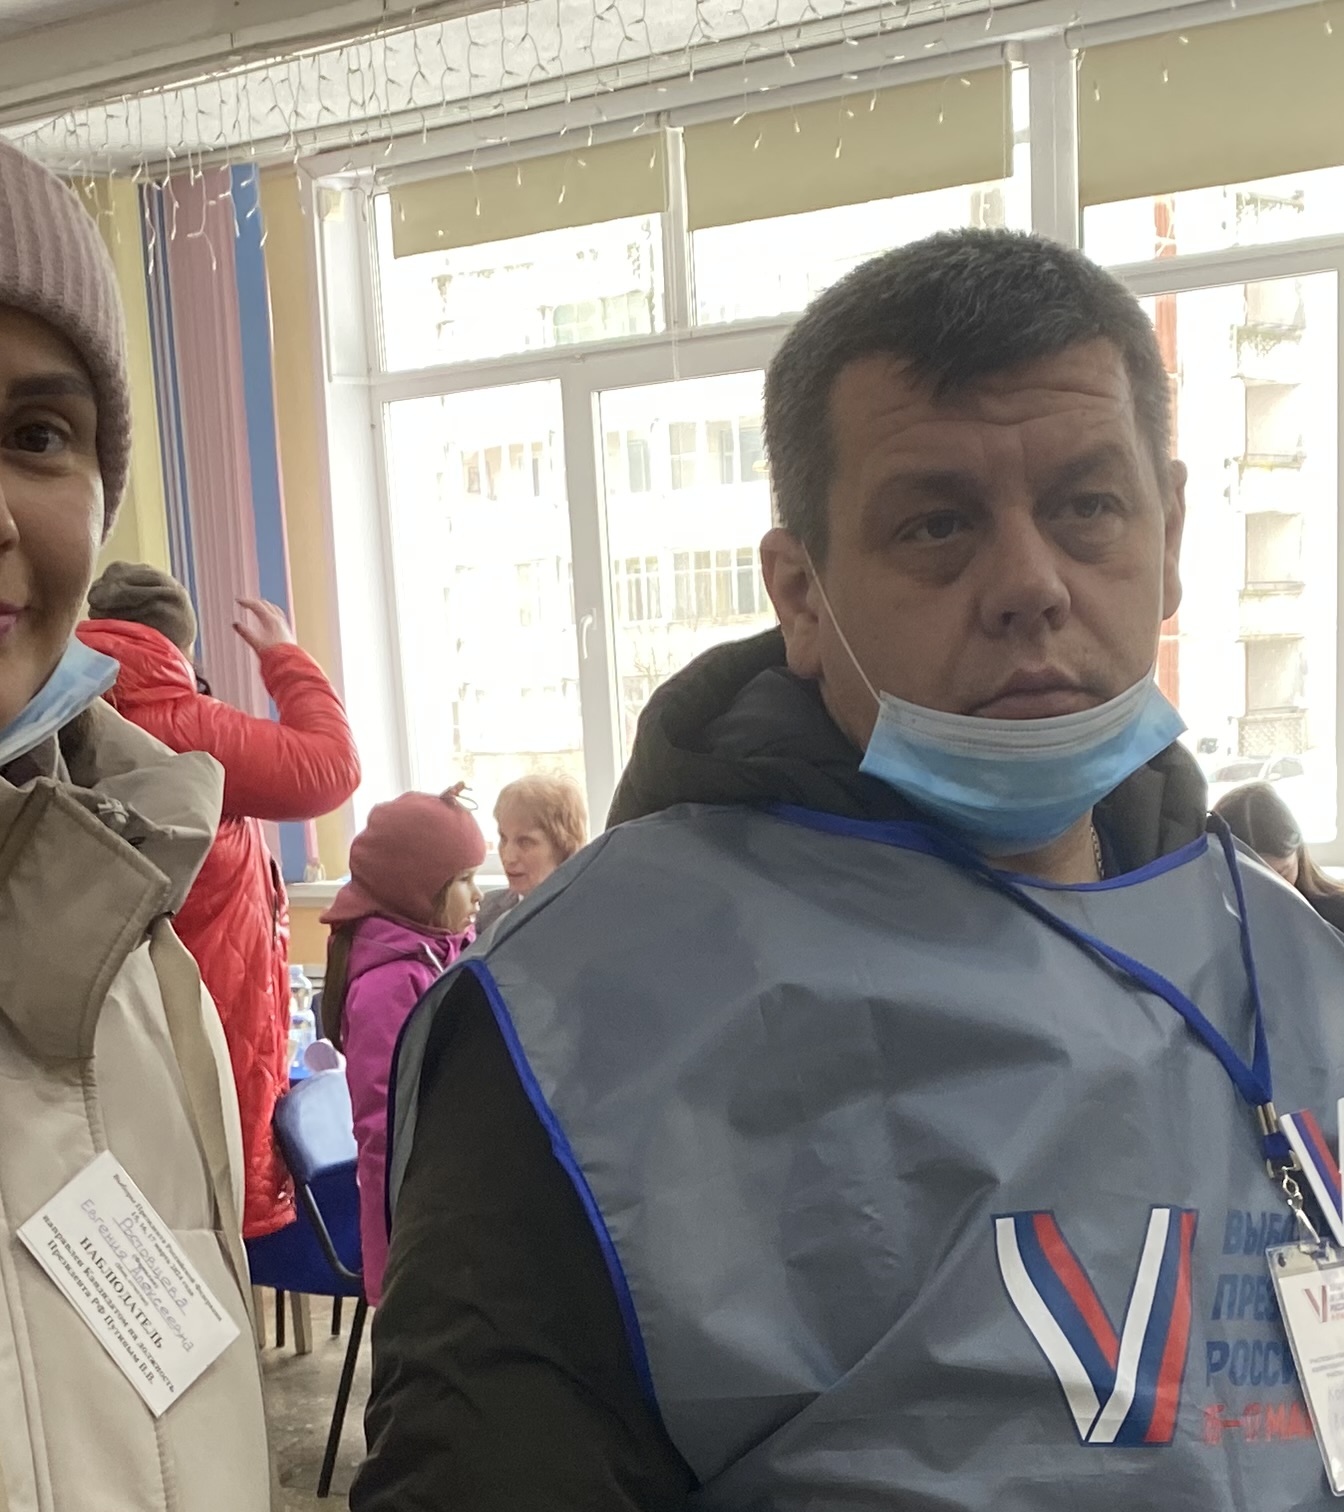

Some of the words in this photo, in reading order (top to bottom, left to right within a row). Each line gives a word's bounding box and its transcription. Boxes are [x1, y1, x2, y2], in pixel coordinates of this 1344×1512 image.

[79, 1198, 131, 1261] Евгения
[40, 1214, 84, 1268] направлен
[81, 1266, 130, 1327] Кандидатом
[126, 1327, 139, 1341] на
[135, 1340, 177, 1393] должность
[44, 1238, 94, 1299] Президента
[90, 1296, 107, 1316] РФ
[101, 1314, 142, 1364] Путиным
[78, 1236, 167, 1349] НАБЛЮДАТЕЛЬ
